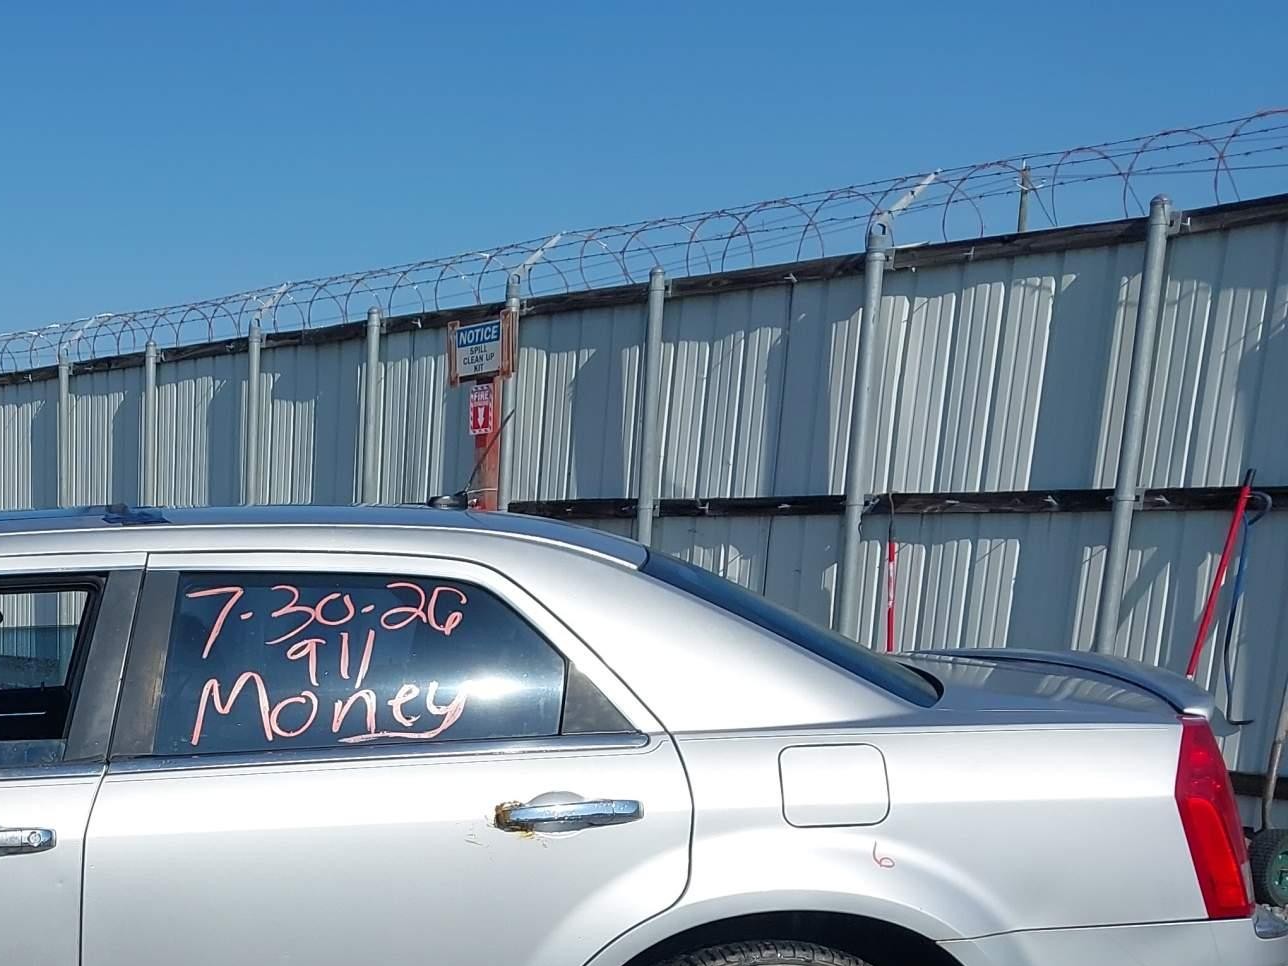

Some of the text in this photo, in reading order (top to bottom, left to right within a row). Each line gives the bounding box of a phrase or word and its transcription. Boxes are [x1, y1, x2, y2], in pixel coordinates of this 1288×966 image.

[459, 325, 499, 345] NOTICE
[469, 344, 487, 355] SPILL
[463, 352, 495, 365] CLEAN UP
[473, 364, 484, 372] KIT
[473, 390, 489, 401] FIRE
[287, 628, 376, 688] 911
[190, 671, 468, 745] Money
[872, 839, 896, 869] 6
